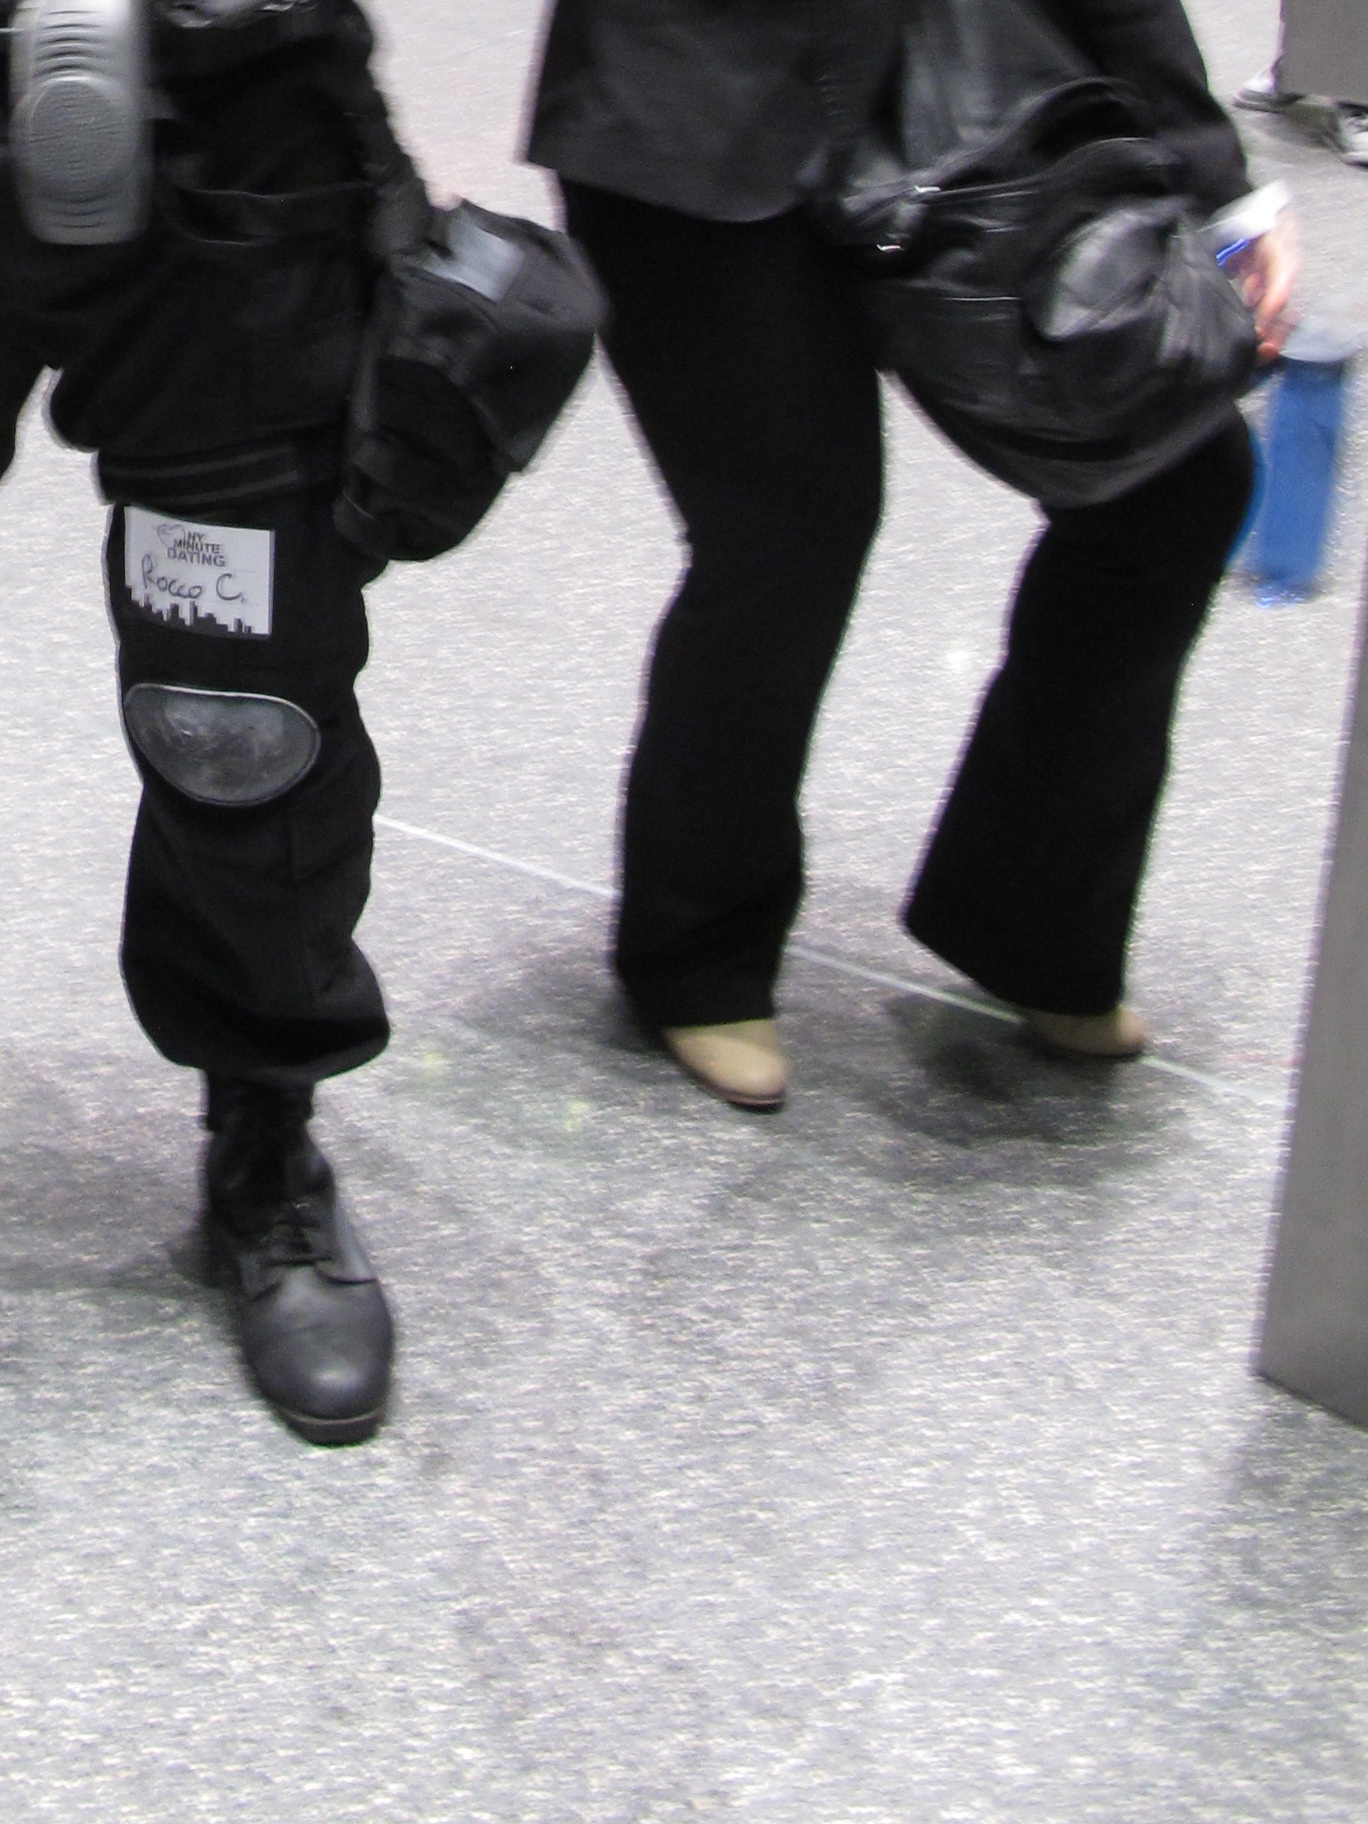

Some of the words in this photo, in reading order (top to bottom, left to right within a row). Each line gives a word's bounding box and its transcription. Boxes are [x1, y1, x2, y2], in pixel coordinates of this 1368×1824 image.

[186, 530, 205, 542] NY
[173, 537, 222, 554] MINUTE
[166, 547, 227, 568] DATING
